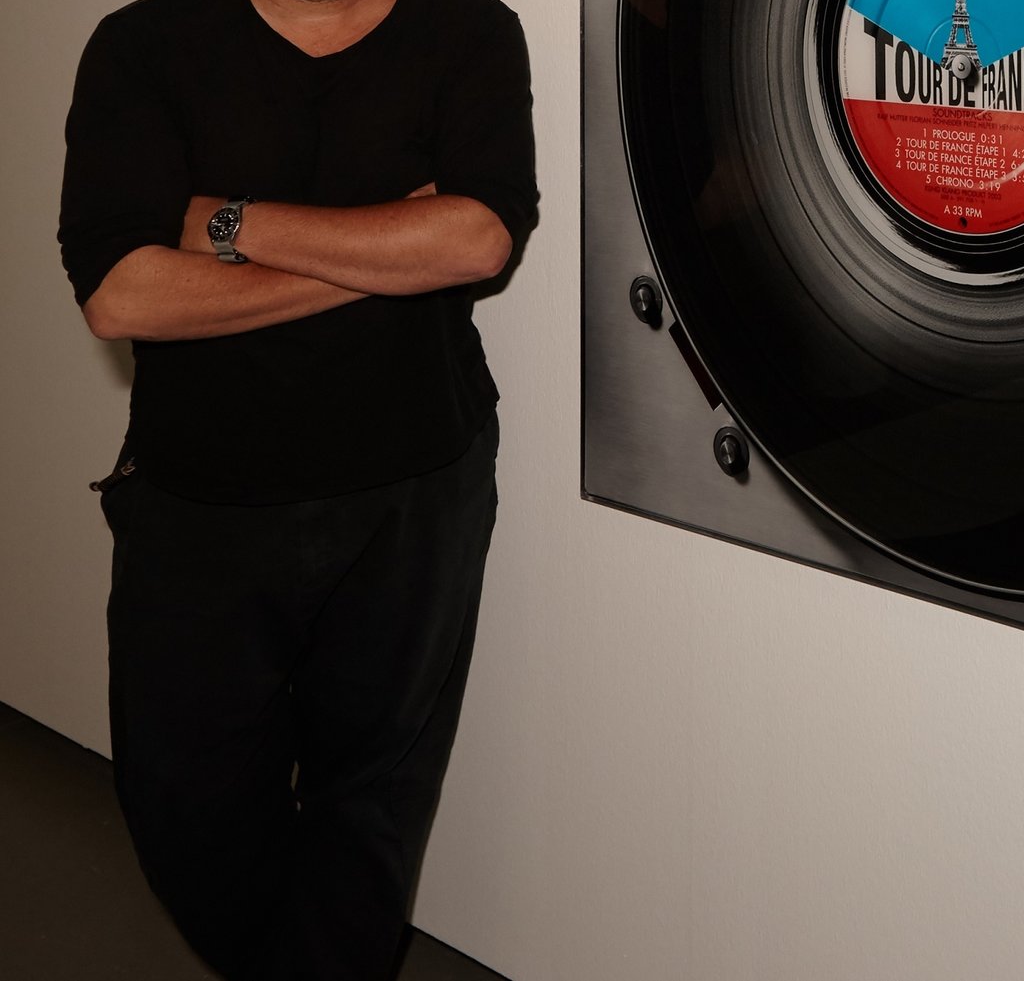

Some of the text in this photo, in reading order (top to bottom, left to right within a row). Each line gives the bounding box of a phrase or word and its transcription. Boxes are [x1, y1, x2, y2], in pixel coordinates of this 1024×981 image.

[864, 17, 943, 105] TOUR
[950, 70, 976, 108] DE
[932, 108, 993, 122] SOUNDTRACKS
[932, 129, 975, 143] PROLOGUE
[980, 134, 1003, 144] 0:31
[896, 138, 901, 147] 2
[906, 138, 927, 149] TOUR
[930, 140, 939, 150] DE
[942, 141, 973, 154] FRANCE
[976, 143, 999, 157] ÉTAPE
[895, 148, 900, 158] 3
[905, 149, 926, 160] TOUR
[928, 151, 938, 161] DE
[940, 154, 972, 166] FRANCE
[974, 155, 997, 168] ÉTAPE
[1000, 159, 1005, 169] 2
[896, 160, 901, 169] 4
[906, 161, 927, 172] TOUR
[929, 163, 939, 173] DE
[941, 165, 973, 177] FRANCE
[975, 167, 998, 180] ÉTAPE
[1001, 171, 1006, 180] 3
[925, 174, 1001, 191] 5 CHRONO 3:19
[944, 205, 983, 218] A 33 RPM
